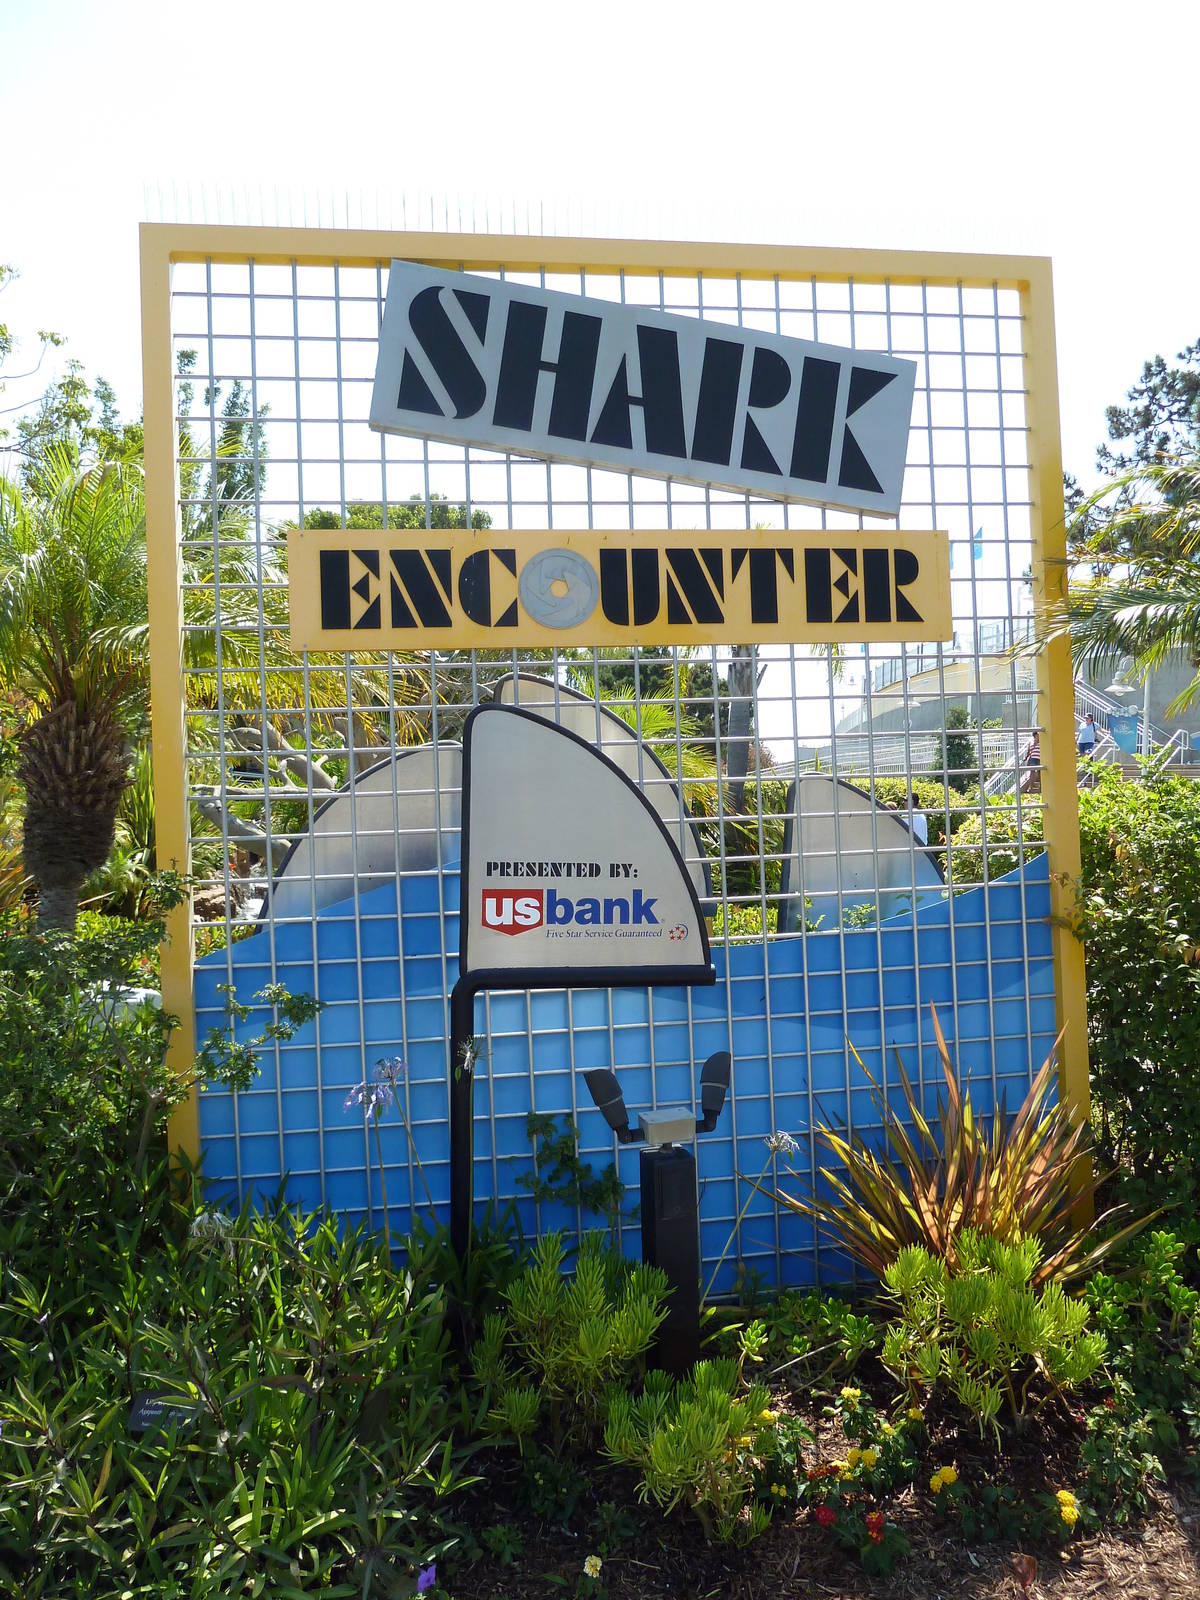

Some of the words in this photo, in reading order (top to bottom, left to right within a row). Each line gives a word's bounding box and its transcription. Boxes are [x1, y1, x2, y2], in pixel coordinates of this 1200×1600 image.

[397, 285, 898, 494] SHARK
[319, 547, 925, 630] ENCOUNTER
[486, 861, 601, 878] PRESENTED
[609, 863, 638, 878] BY:
[546, 929, 564, 938] Five
[566, 929, 582, 938] Star
[584, 929, 613, 938] Service
[614, 929, 663, 938] Guaranteed
